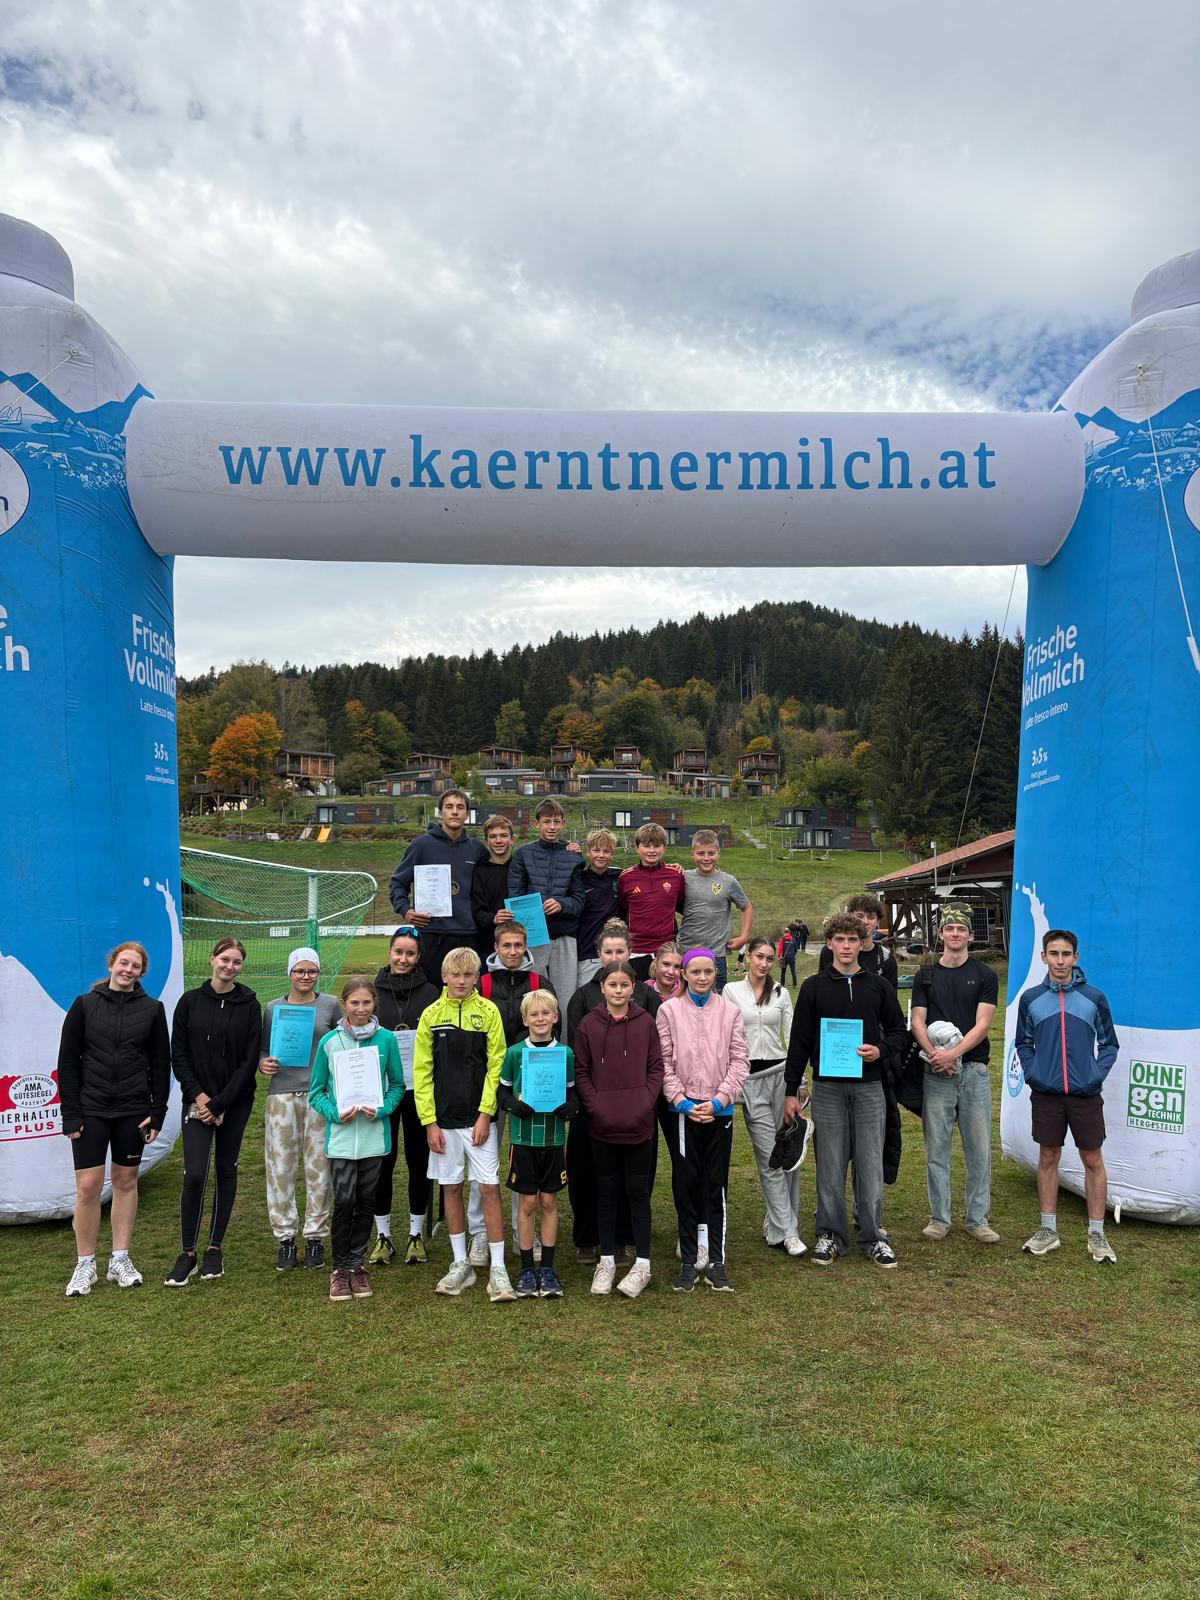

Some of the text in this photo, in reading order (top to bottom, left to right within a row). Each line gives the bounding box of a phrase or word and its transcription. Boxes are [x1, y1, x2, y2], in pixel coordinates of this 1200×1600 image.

[218, 433, 997, 492] www.kaerntnermilch.at
[132, 613, 174, 665] Frische
[1026, 624, 1078, 675] Frische
[1132, 1062, 1184, 1089] OHNE
[13, 1089, 53, 1100] GÜTESIEGEL
[24, 1082, 42, 1092] AMA
[1130, 1087, 1182, 1116] gen
[1129, 1118, 1181, 1132] HERGESTELLT
[1147, 1109, 1182, 1122] TECHNIK
[14, 1121, 55, 1134] PLUS
